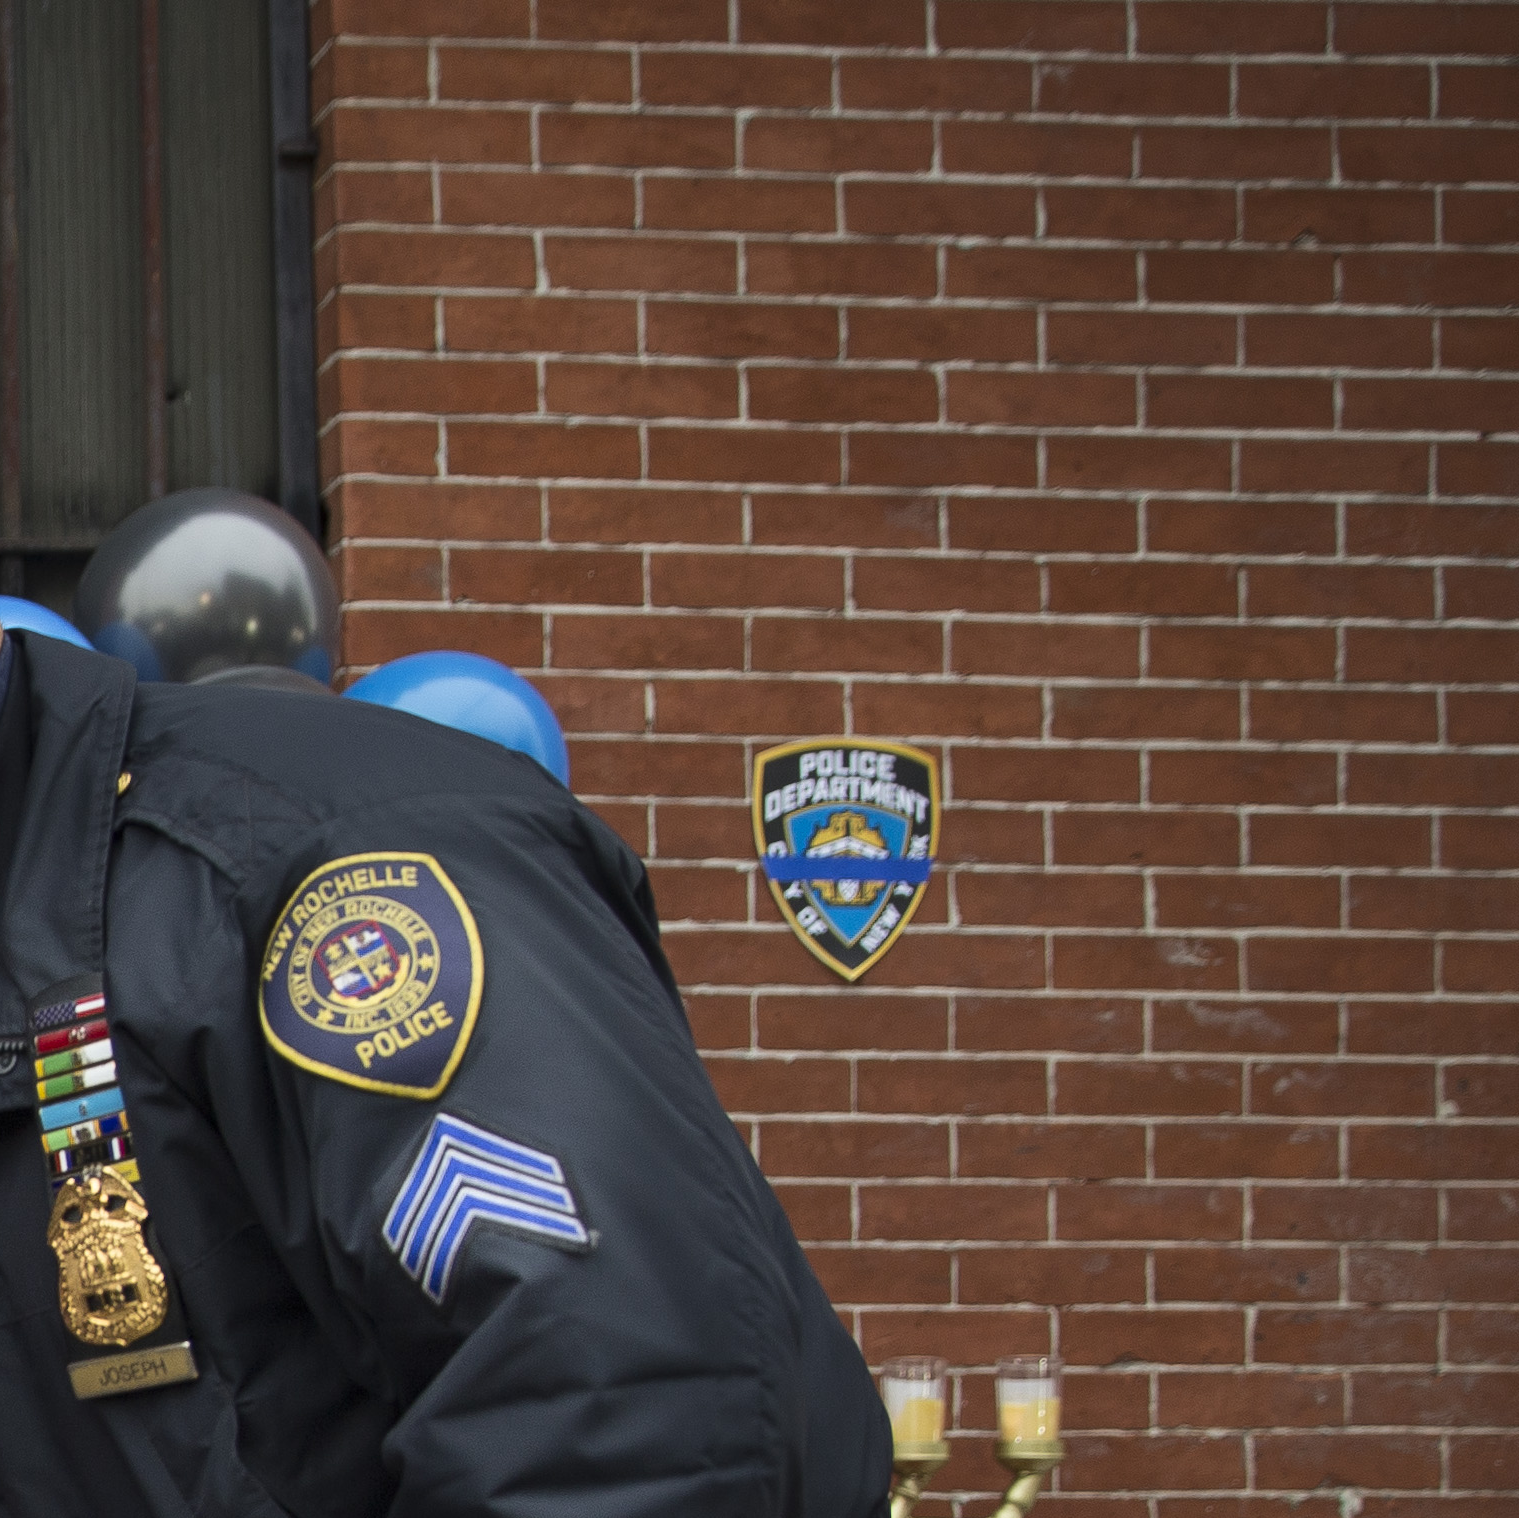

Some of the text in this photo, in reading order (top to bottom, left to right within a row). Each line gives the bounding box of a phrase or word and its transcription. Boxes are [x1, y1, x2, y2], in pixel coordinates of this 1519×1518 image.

[799, 749, 897, 782] POLICE
[764, 775, 930, 824] DEPARTMENT
[263, 866, 419, 982] NEW ROCHELLE
[306, 908, 340, 941] NEW
[797, 905, 829, 937] OF
[859, 902, 901, 953] NEW
[354, 1000, 454, 1069] POLICE
[99, 1357, 168, 1387] JOSEPH
